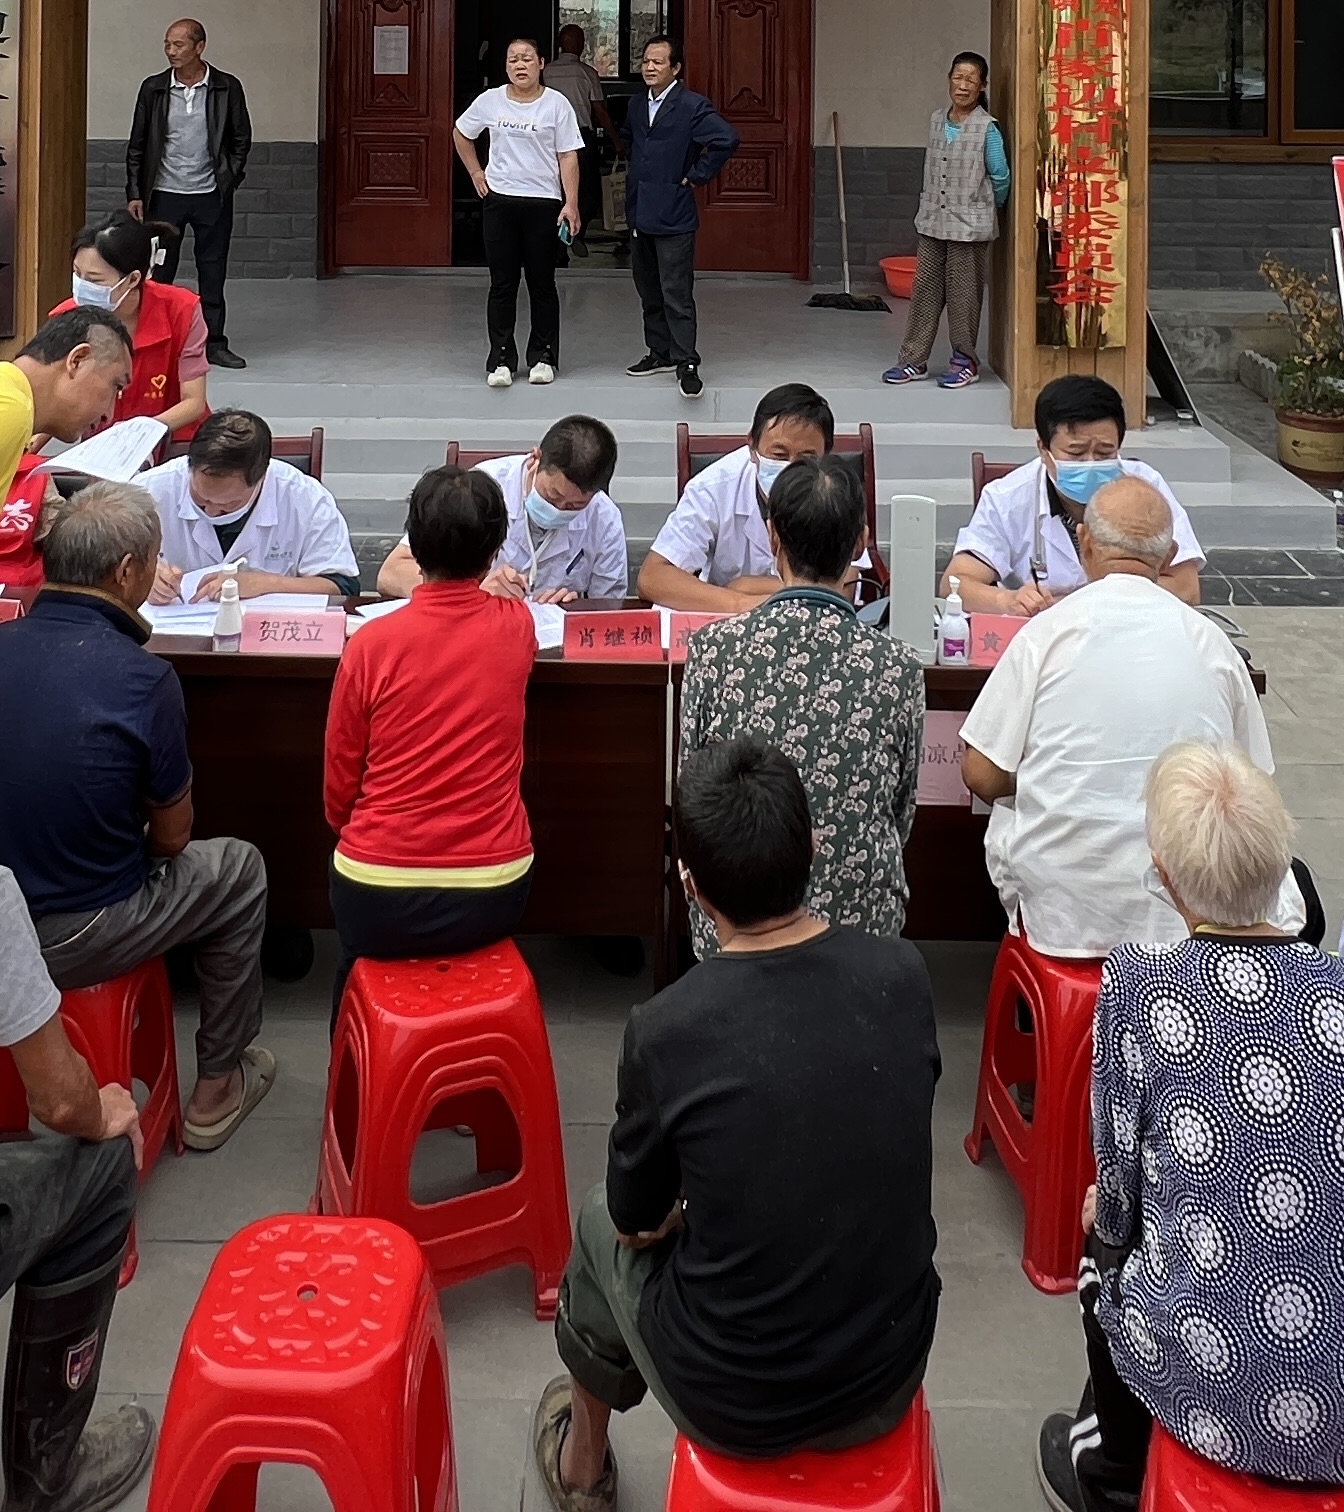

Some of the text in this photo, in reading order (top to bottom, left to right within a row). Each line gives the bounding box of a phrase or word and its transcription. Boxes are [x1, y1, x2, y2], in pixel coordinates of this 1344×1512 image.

[0, 498, 34, 531] 志
[258, 620, 324, 642] 贺茂立
